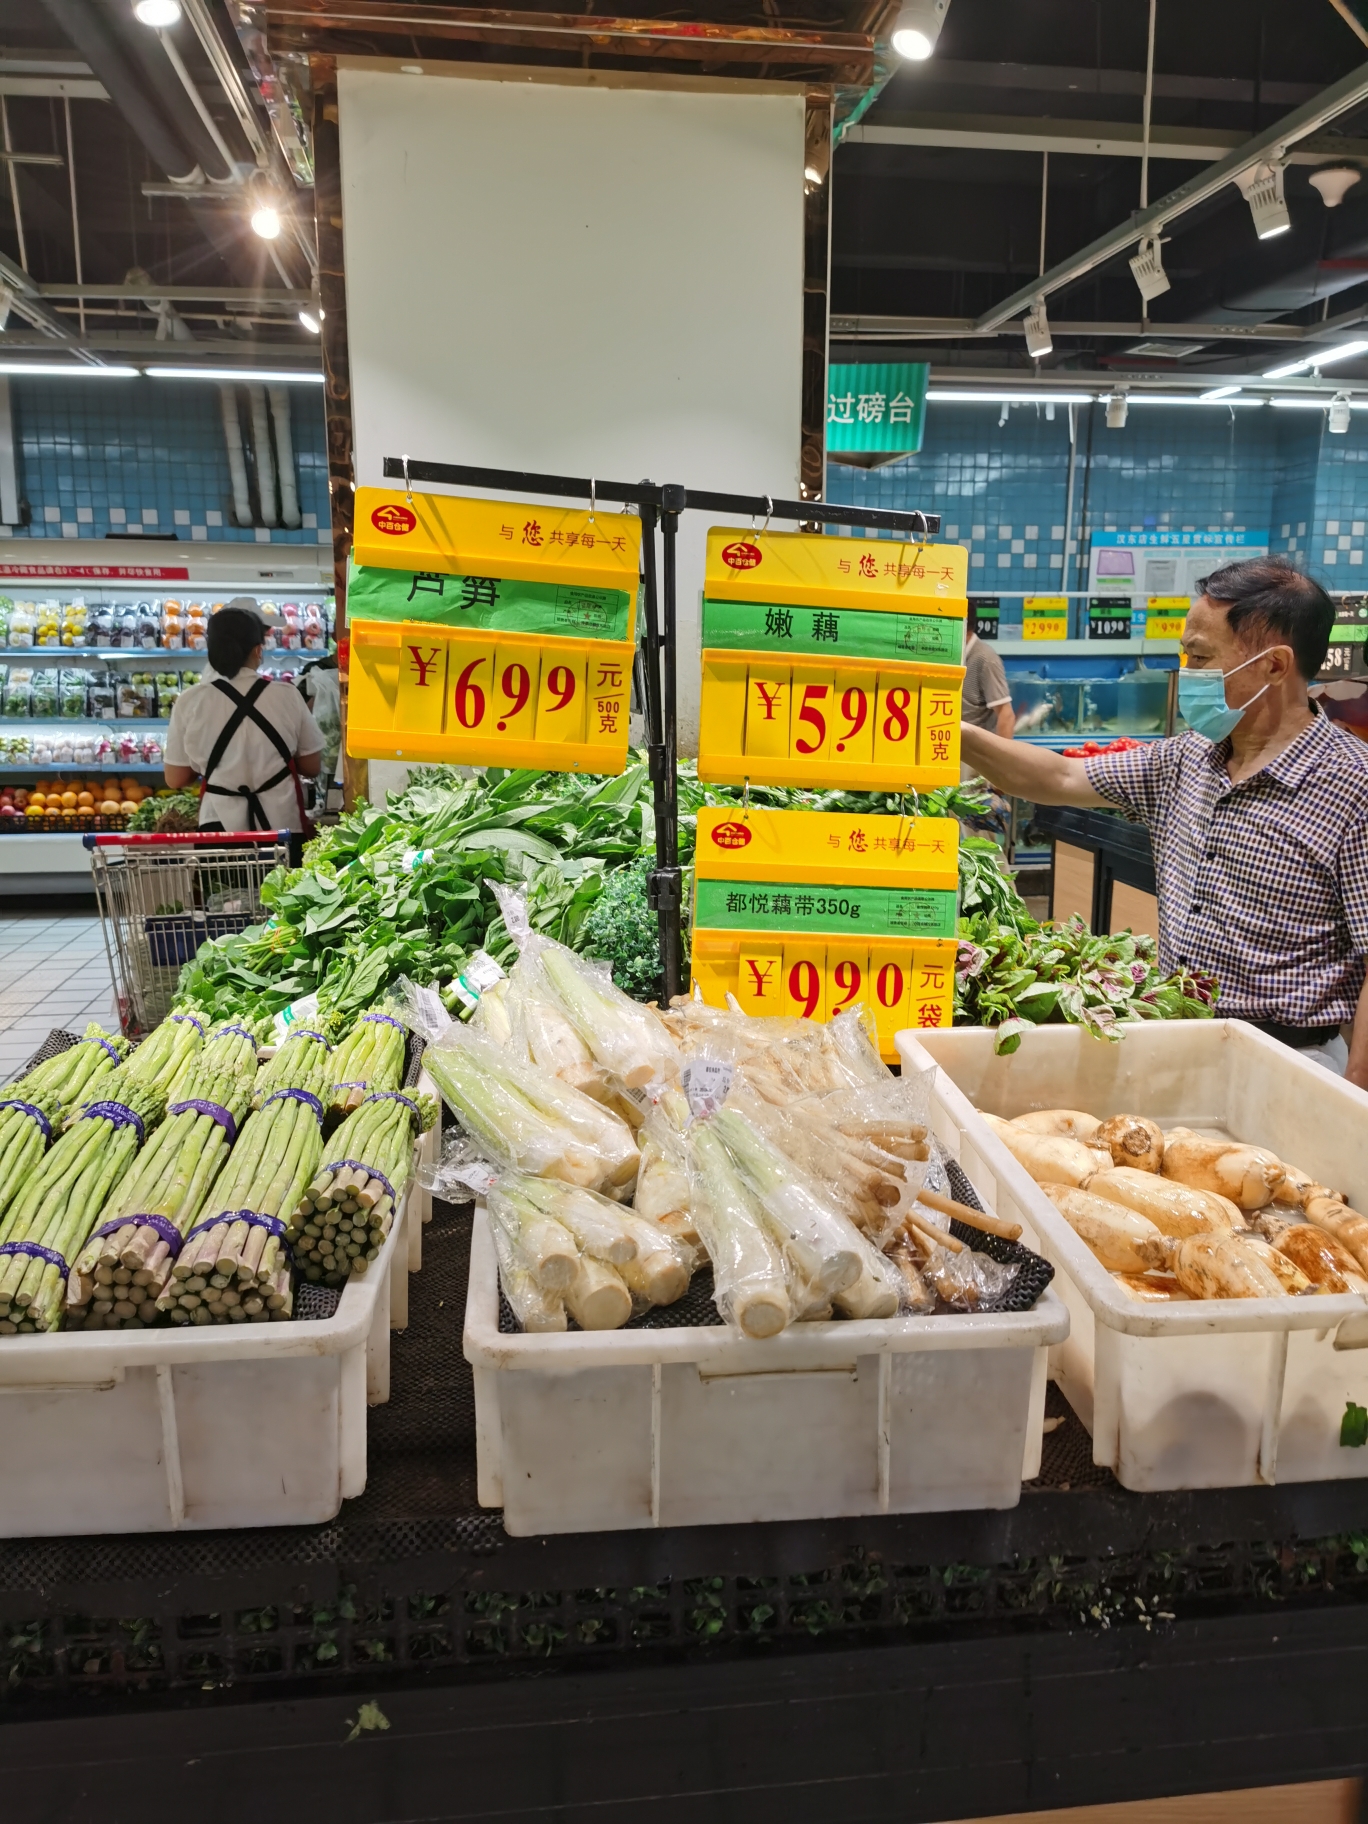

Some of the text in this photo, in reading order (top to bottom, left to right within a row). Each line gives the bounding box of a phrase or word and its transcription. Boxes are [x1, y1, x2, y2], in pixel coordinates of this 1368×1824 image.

[827, 391, 914, 424] 过磅台
[764, 607, 840, 643] 嫩藕
[725, 891, 862, 919] 都悦藕带350g
